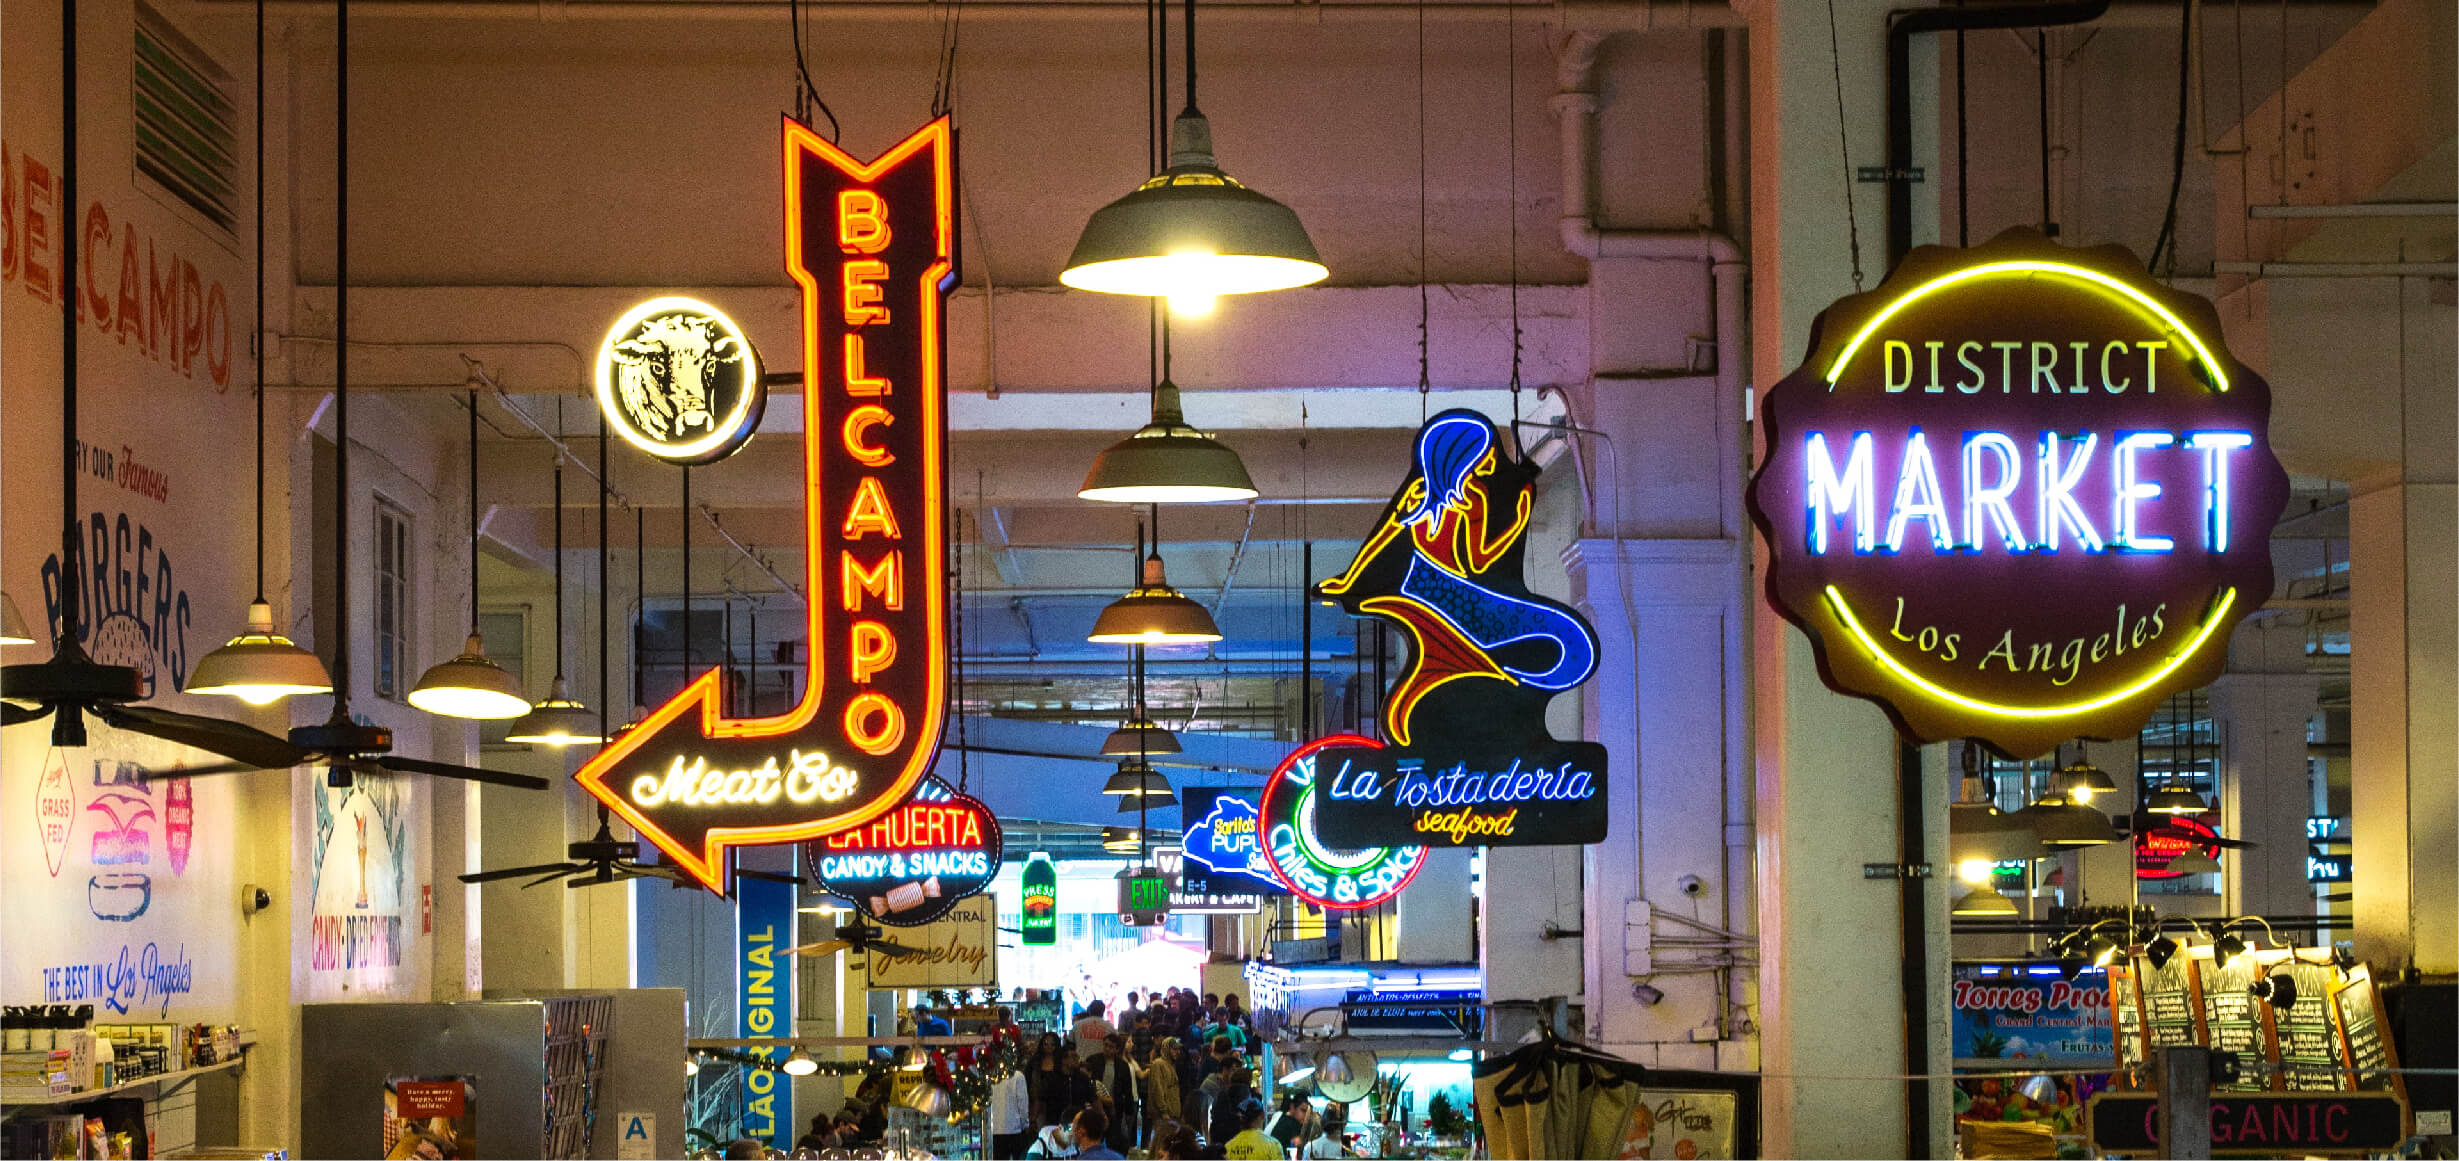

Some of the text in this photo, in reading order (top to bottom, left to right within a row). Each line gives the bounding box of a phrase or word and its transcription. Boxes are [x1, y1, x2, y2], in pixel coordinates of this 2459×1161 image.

[1884, 340, 2167, 394] DISTRICT
[92, 446, 114, 482] OUR
[118, 444, 168, 504] Famous
[838, 190, 906, 756] BELCAMPO
[1804, 425, 2253, 556] MARKET
[1890, 596, 2167, 686] Los Angeles
[632, 755, 781, 805] Meat
[1329, 757, 1596, 808] La Tostadería
[42, 797, 70, 818] GRASS
[872, 806, 983, 848] HUERTA
[1414, 805, 1518, 845] seafood
[47, 823, 64, 845] FED
[821, 850, 988, 880] CANDY & SNACKS
[1270, 823, 1328, 897] Chiles
[1334, 875, 1360, 901] &
[1023, 883, 1055, 897] PRESS
[1131, 878, 1164, 910] EXIT
[1187, 880, 1207, 892] E-5
[934, 911, 986, 923] ENTRAL
[312, 915, 342, 971] CANDY
[876, 933, 988, 976] Jewelry
[43, 941, 191, 1020] THE BEST IN Los Angeles
[1954, 980, 2043, 1013] Torres
[625, 1116, 648, 1140] A
[2144, 1104, 2349, 1142] OGANIC
